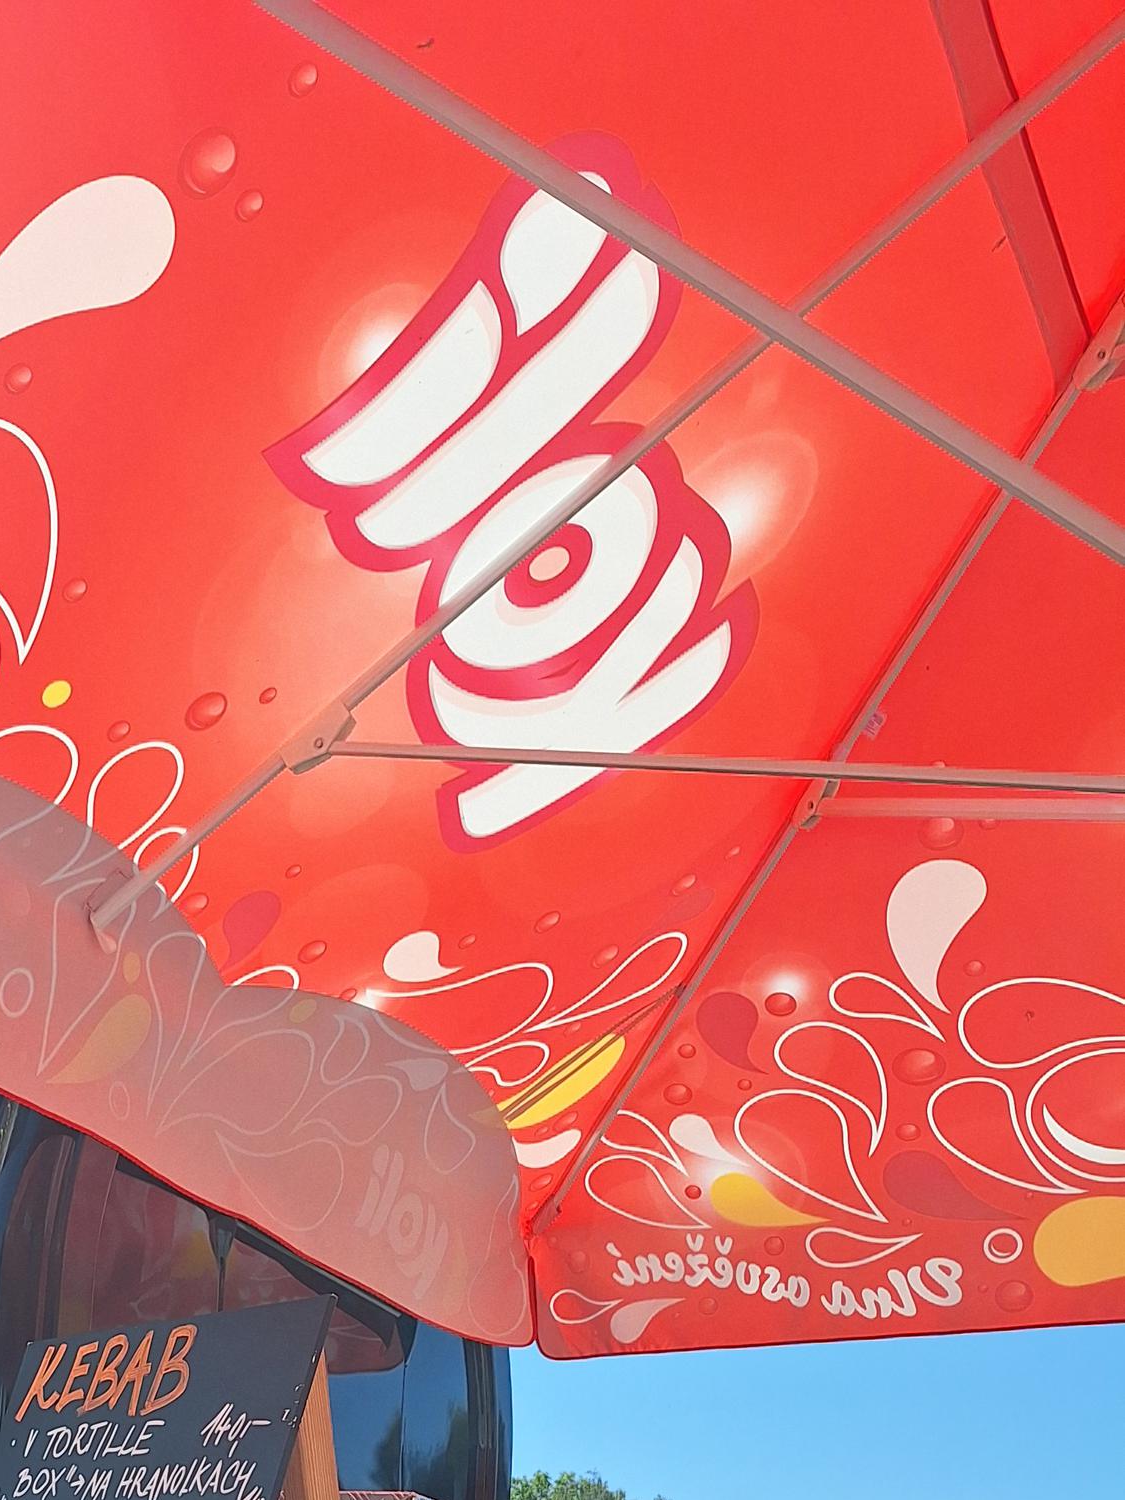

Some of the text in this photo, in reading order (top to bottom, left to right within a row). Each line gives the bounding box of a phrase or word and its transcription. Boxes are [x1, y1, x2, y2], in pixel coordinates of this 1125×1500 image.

[14, 1324, 198, 1422] KEBAB
[22, 1429, 35, 1459] V
[42, 1418, 166, 1461] TORTILLE
